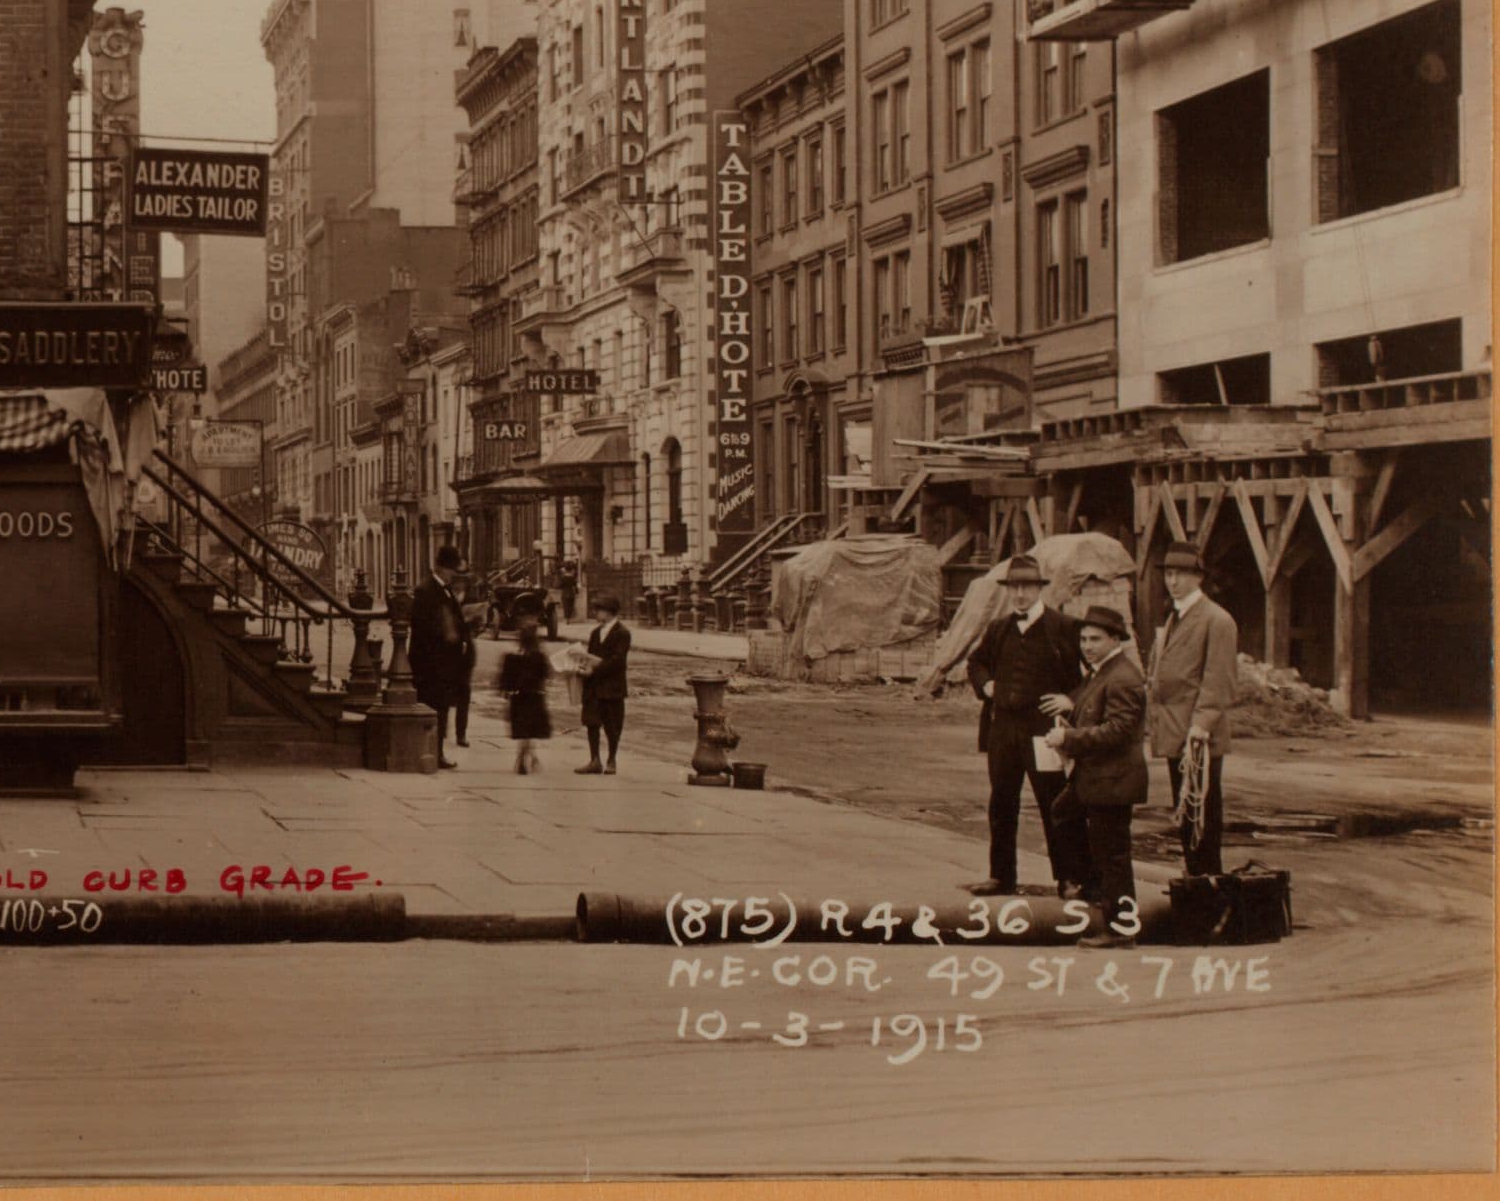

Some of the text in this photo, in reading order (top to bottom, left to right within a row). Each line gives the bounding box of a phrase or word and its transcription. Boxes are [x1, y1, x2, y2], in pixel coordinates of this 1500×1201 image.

[135, 161, 261, 189] ALEXANDER
[134, 195, 258, 221] LADIES TAILOR
[268, 178, 286, 347] BRISTOL
[717, 123, 750, 422] TABLE D'HOTE
[528, 374, 592, 391] HOTEL
[485, 424, 527, 439] BAR
[719, 463, 753, 497] MUSIC
[718, 484, 757, 522] DANCING
